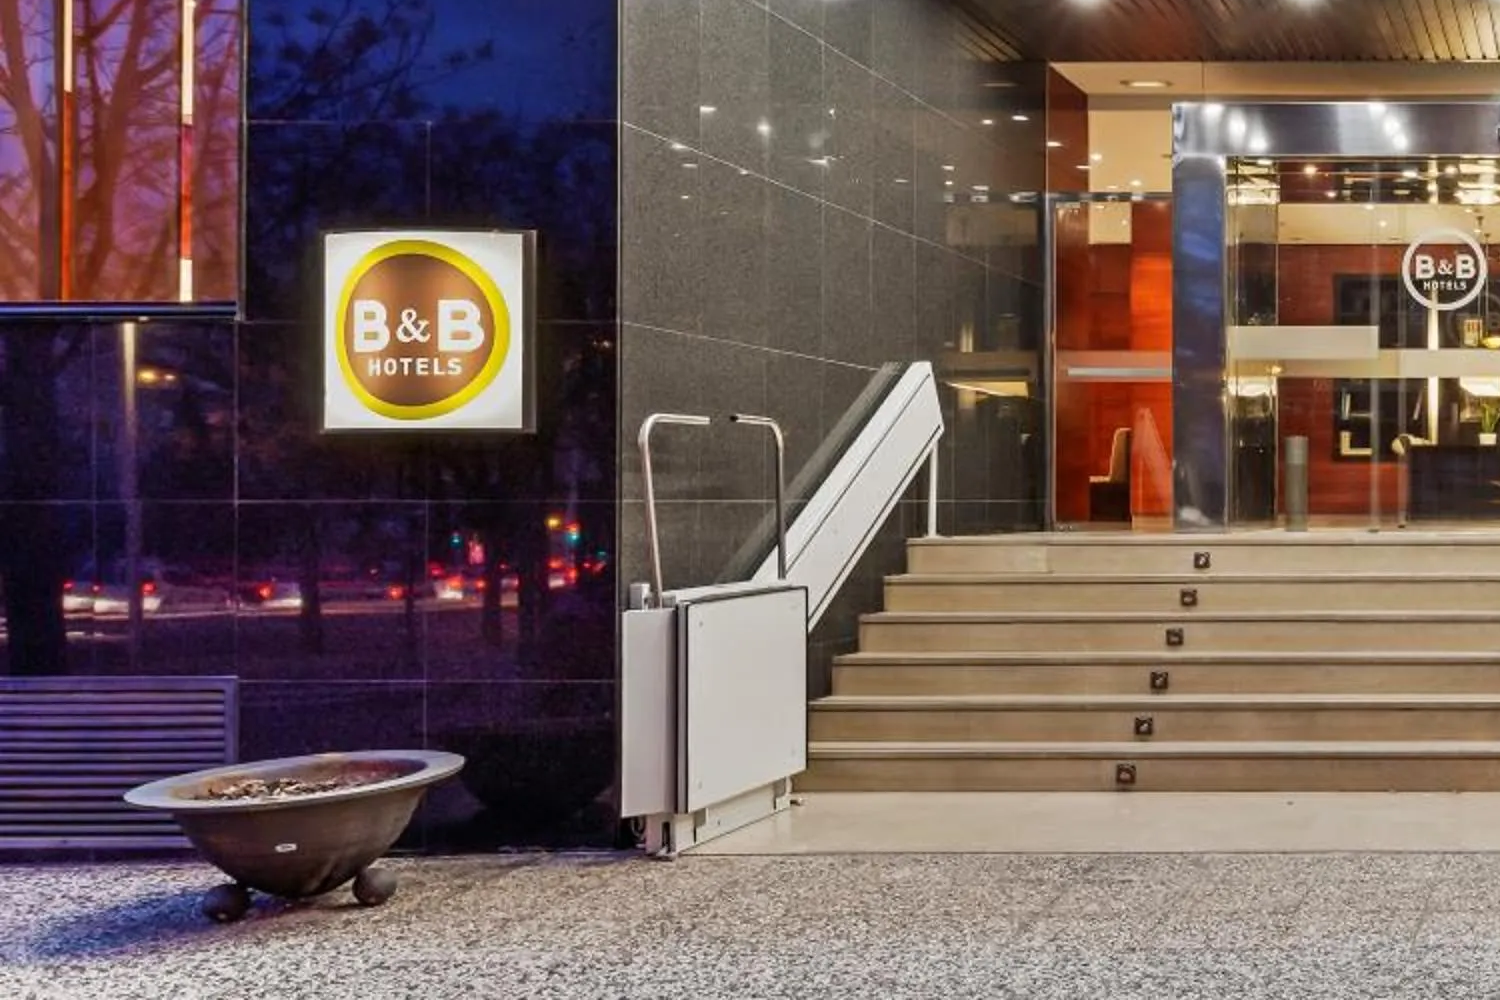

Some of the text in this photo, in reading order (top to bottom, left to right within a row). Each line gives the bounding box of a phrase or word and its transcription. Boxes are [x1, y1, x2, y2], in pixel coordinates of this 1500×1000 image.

[1415, 254, 1476, 279] B&B
[1423, 281, 1467, 291] HOTELS
[353, 299, 485, 353] B&B
[367, 357, 463, 377] HOTELS
